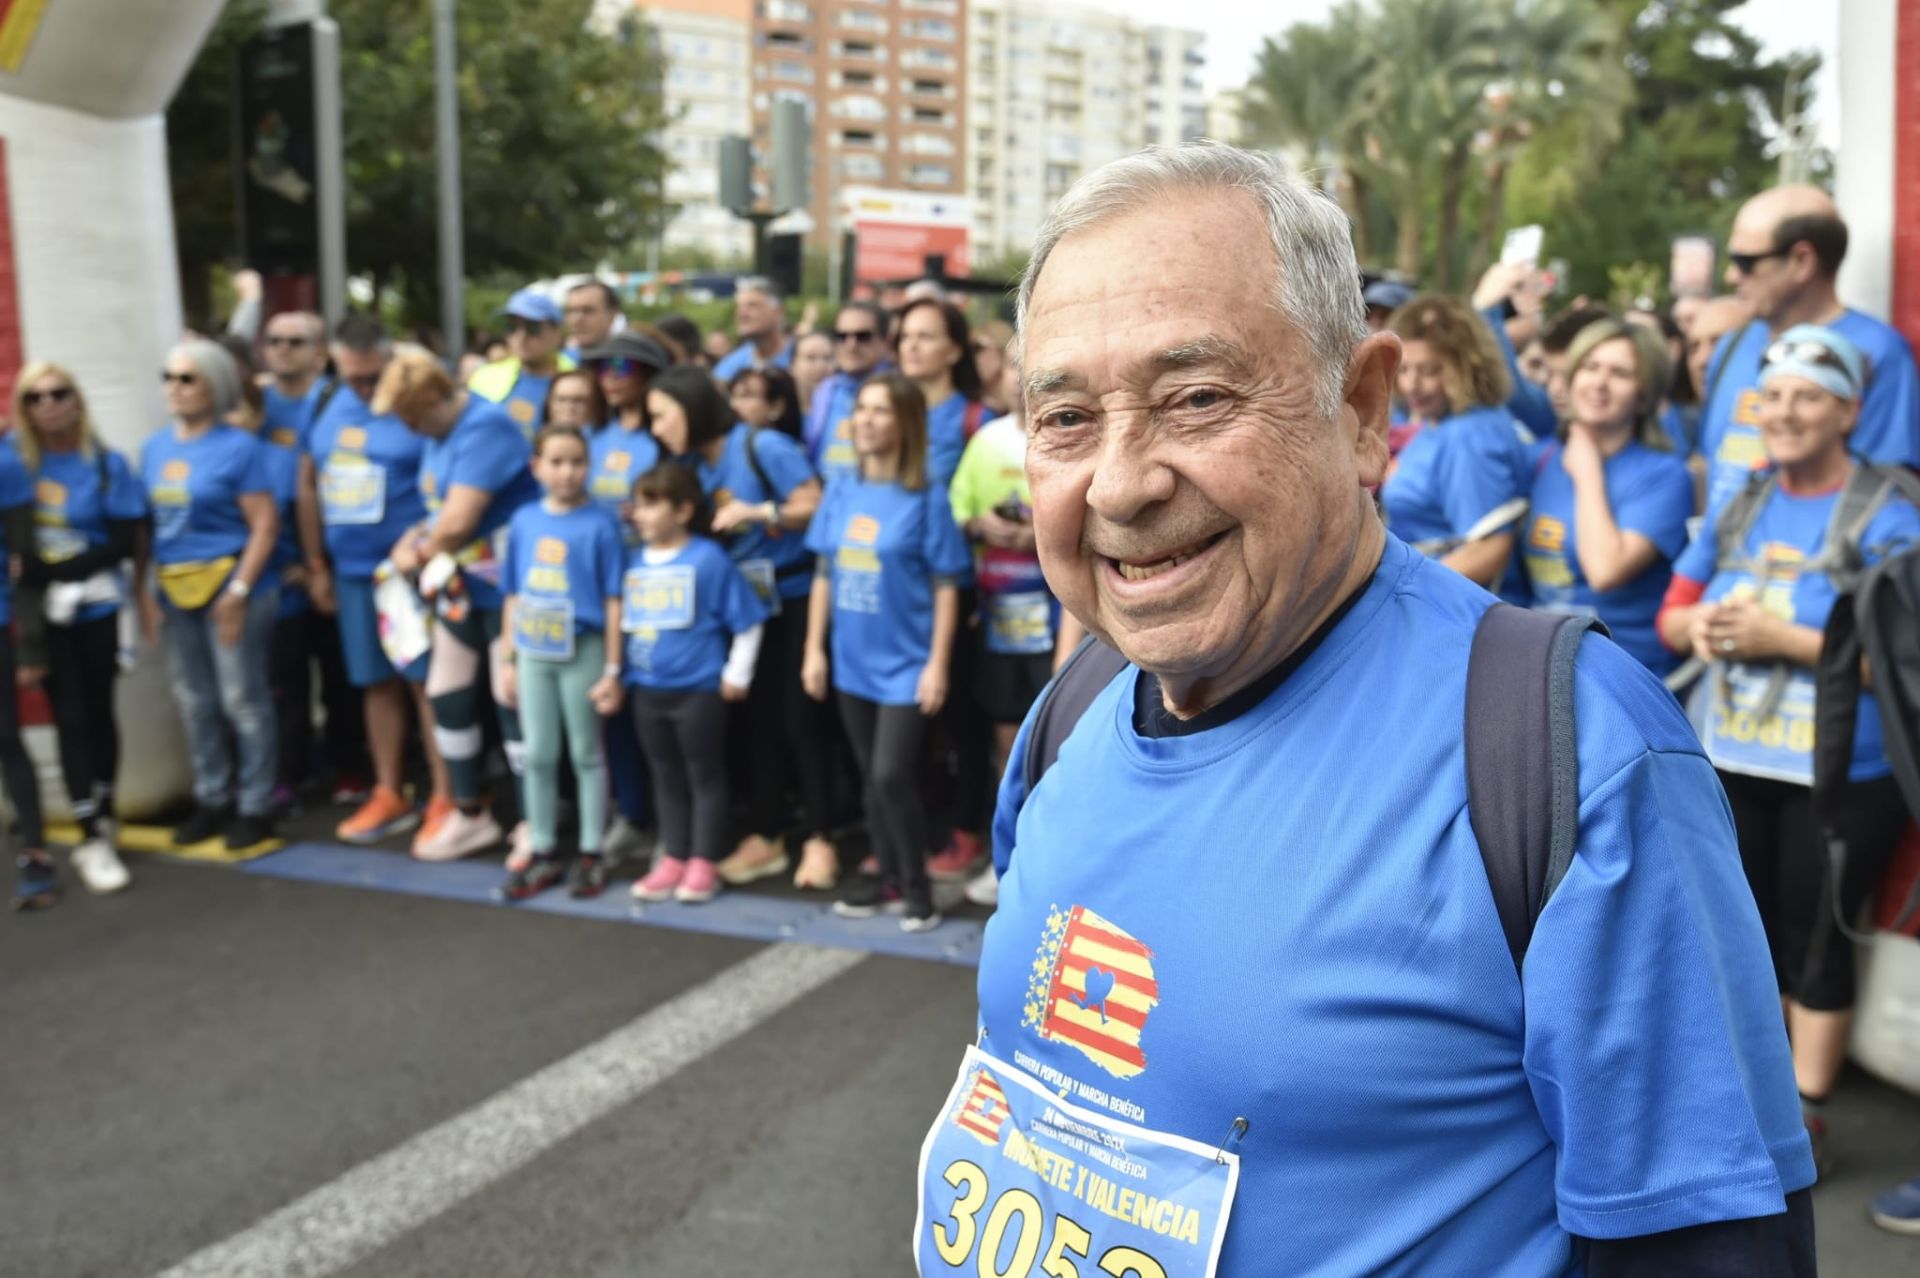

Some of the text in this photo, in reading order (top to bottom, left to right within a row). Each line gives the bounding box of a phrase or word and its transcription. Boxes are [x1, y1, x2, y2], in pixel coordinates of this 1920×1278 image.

[1040, 1064, 1073, 1091] POPULAR
[1071, 1078, 1081, 1094] Y
[1078, 1081, 1109, 1108] MARCHA
[1109, 1095, 1145, 1123] BENÉFICA
[1110, 1153, 1147, 1180] BENÉFICA
[1073, 1163, 1090, 1201] X
[1085, 1172, 1200, 1246] VALENCIA
